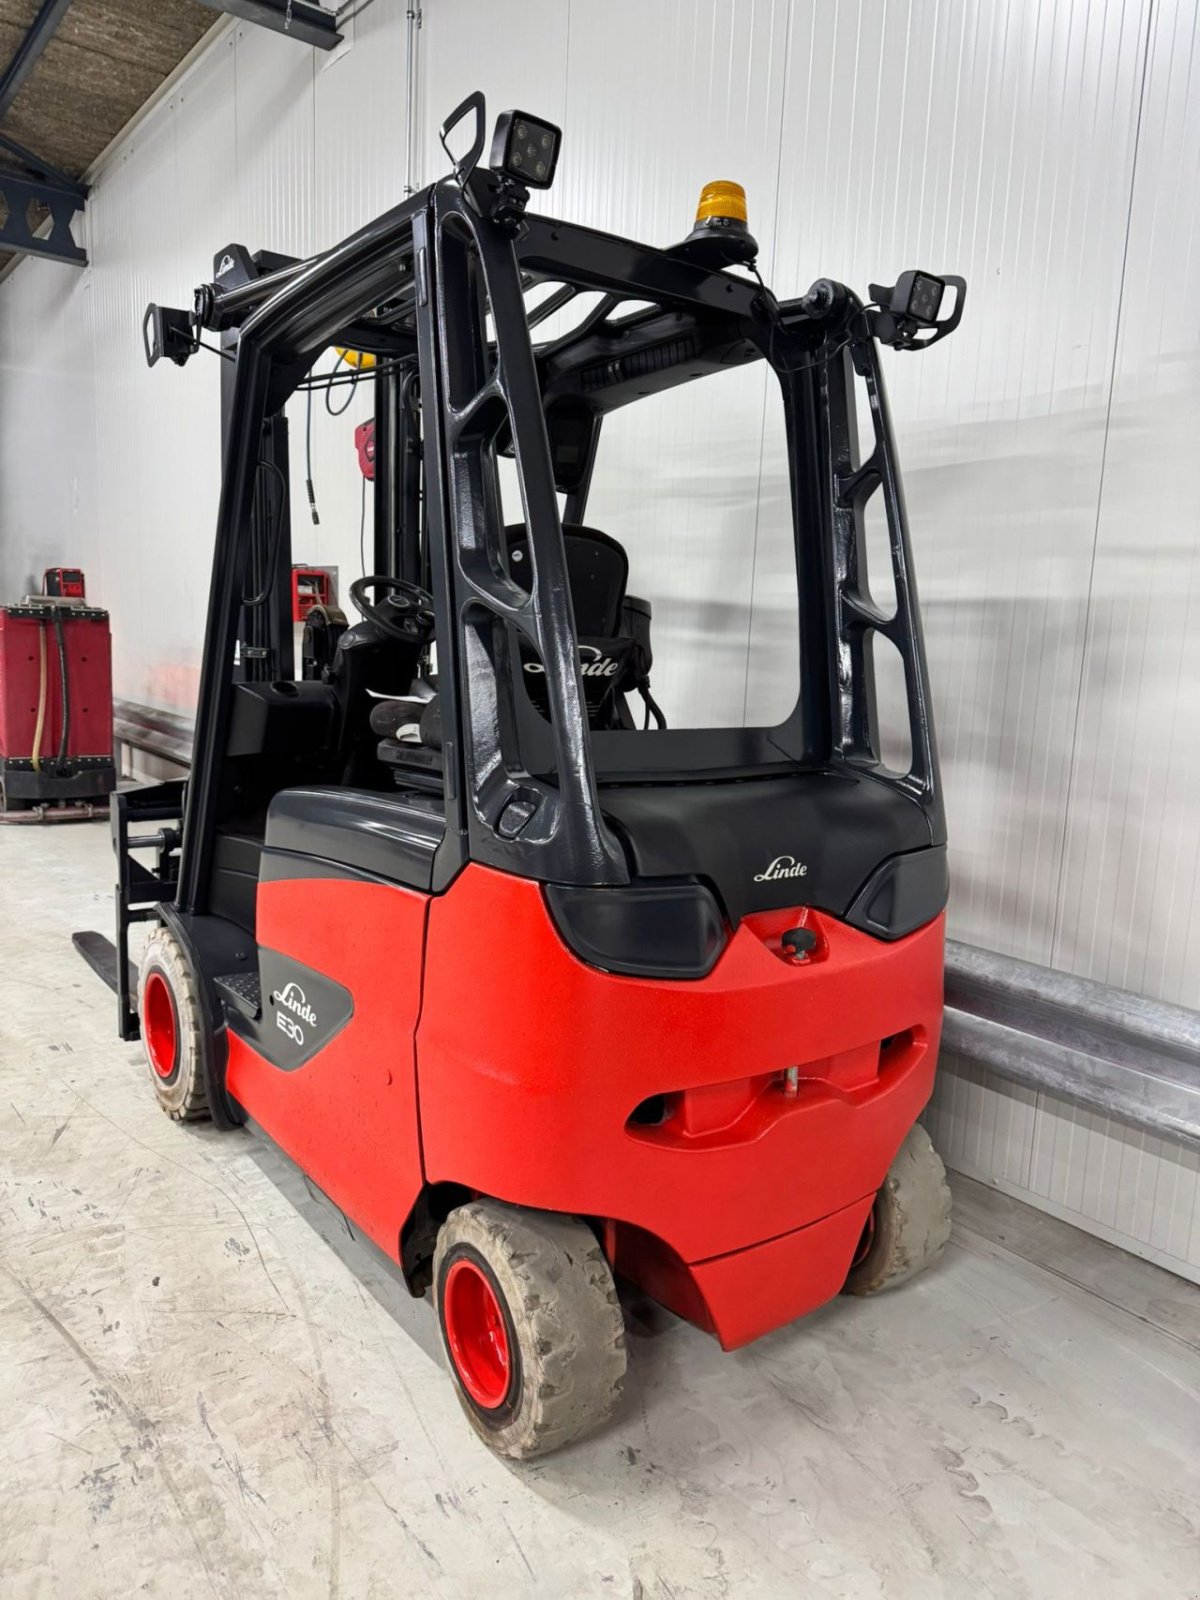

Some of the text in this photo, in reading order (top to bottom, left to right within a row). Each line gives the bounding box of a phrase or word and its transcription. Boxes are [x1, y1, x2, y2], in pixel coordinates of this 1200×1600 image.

[753, 855, 808, 882] Linde
[273, 982, 317, 1027] Linde
[276, 1010, 304, 1046] E30
